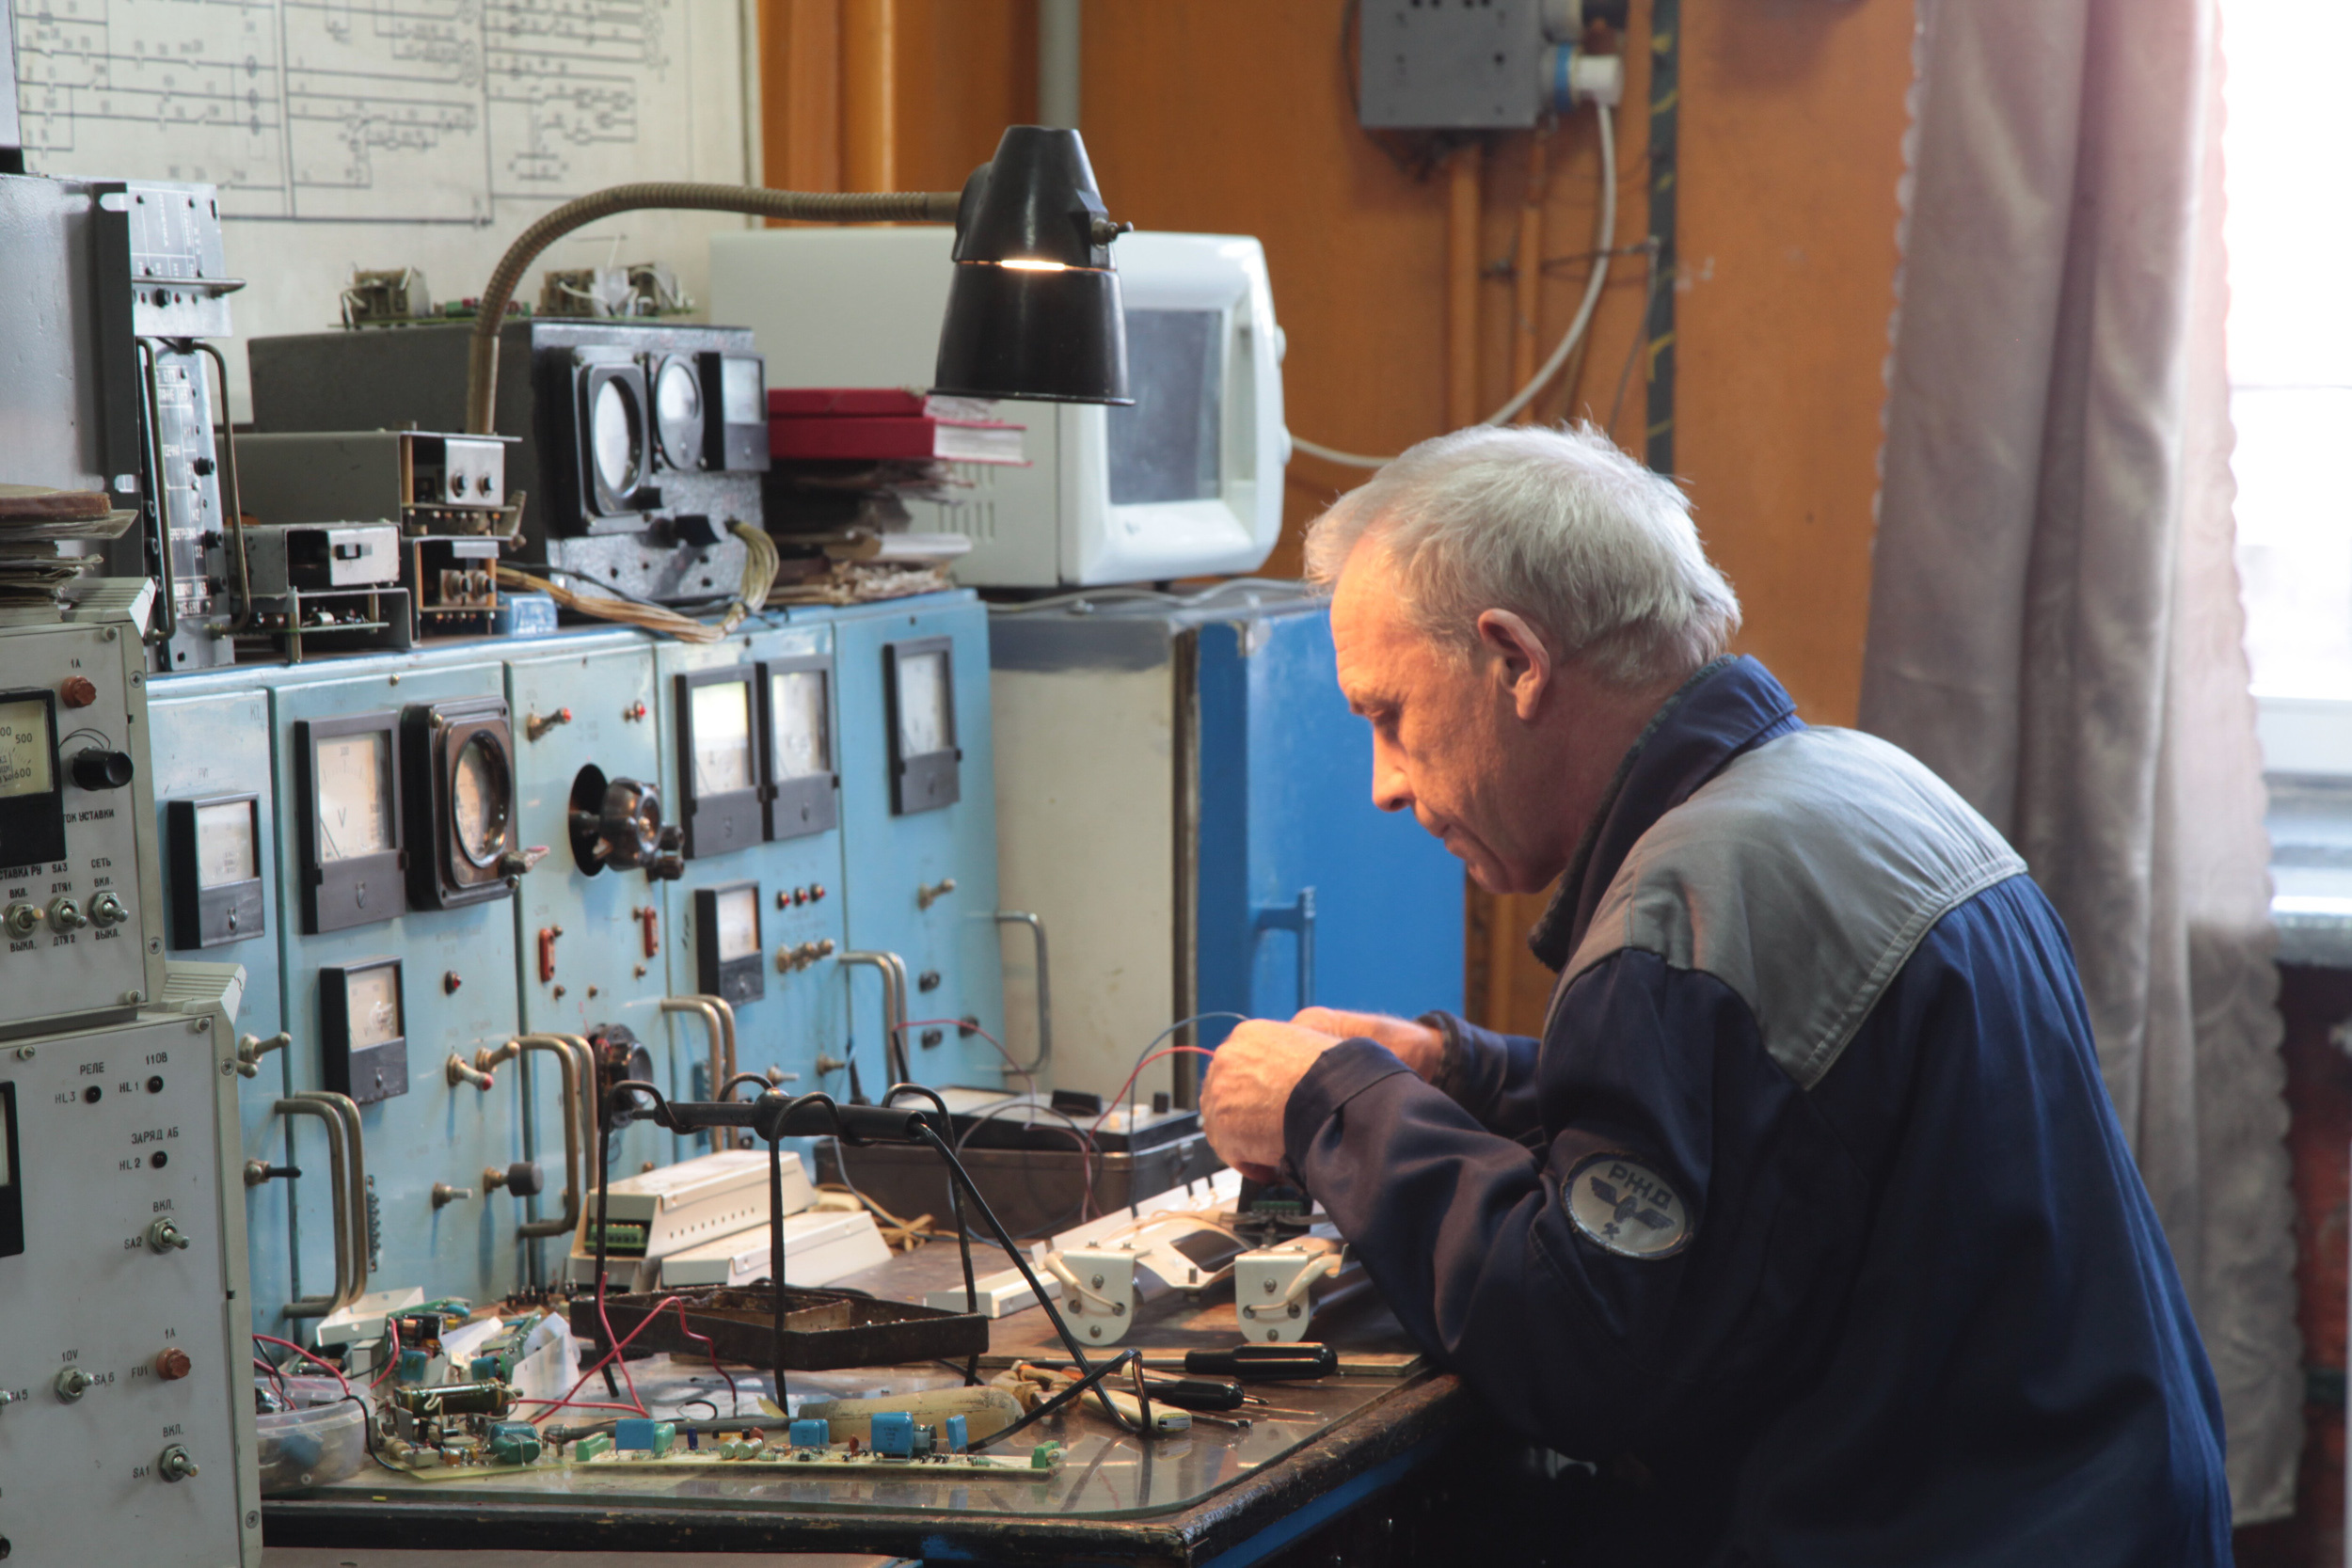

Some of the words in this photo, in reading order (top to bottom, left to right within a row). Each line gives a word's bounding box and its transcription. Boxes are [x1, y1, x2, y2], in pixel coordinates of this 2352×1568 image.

[0, 725, 11, 737] 00
[15, 732, 33, 744] 500
[14, 768, 32, 780] 600
[78, 808, 115, 823] УСТАВКИ
[52, 863, 68, 874] SA3
[91, 857, 112, 869] СЕТЬ
[0, 865, 29, 880] СТАВКА
[30, 863, 42, 877] РУ
[95, 927, 121, 941] ВЫКЛ.
[9, 940, 38, 953] ВЫКЛ.
[79, 1061, 105, 1076] РЕЛЕ
[131, 1130, 164, 1145] ЗАРЯД
[167, 1126, 180, 1139] АБ
[1607, 1162, 1673, 1211] РЖД
[152, 1198, 175, 1213] ВКЛ.
[123, 1236, 143, 1250] SA2
[61, 1349, 79, 1363] 10V
[131, 1365, 149, 1379] FU1
[162, 1423, 184, 1438] ВКЛ.
[133, 1465, 150, 1479] SA1
